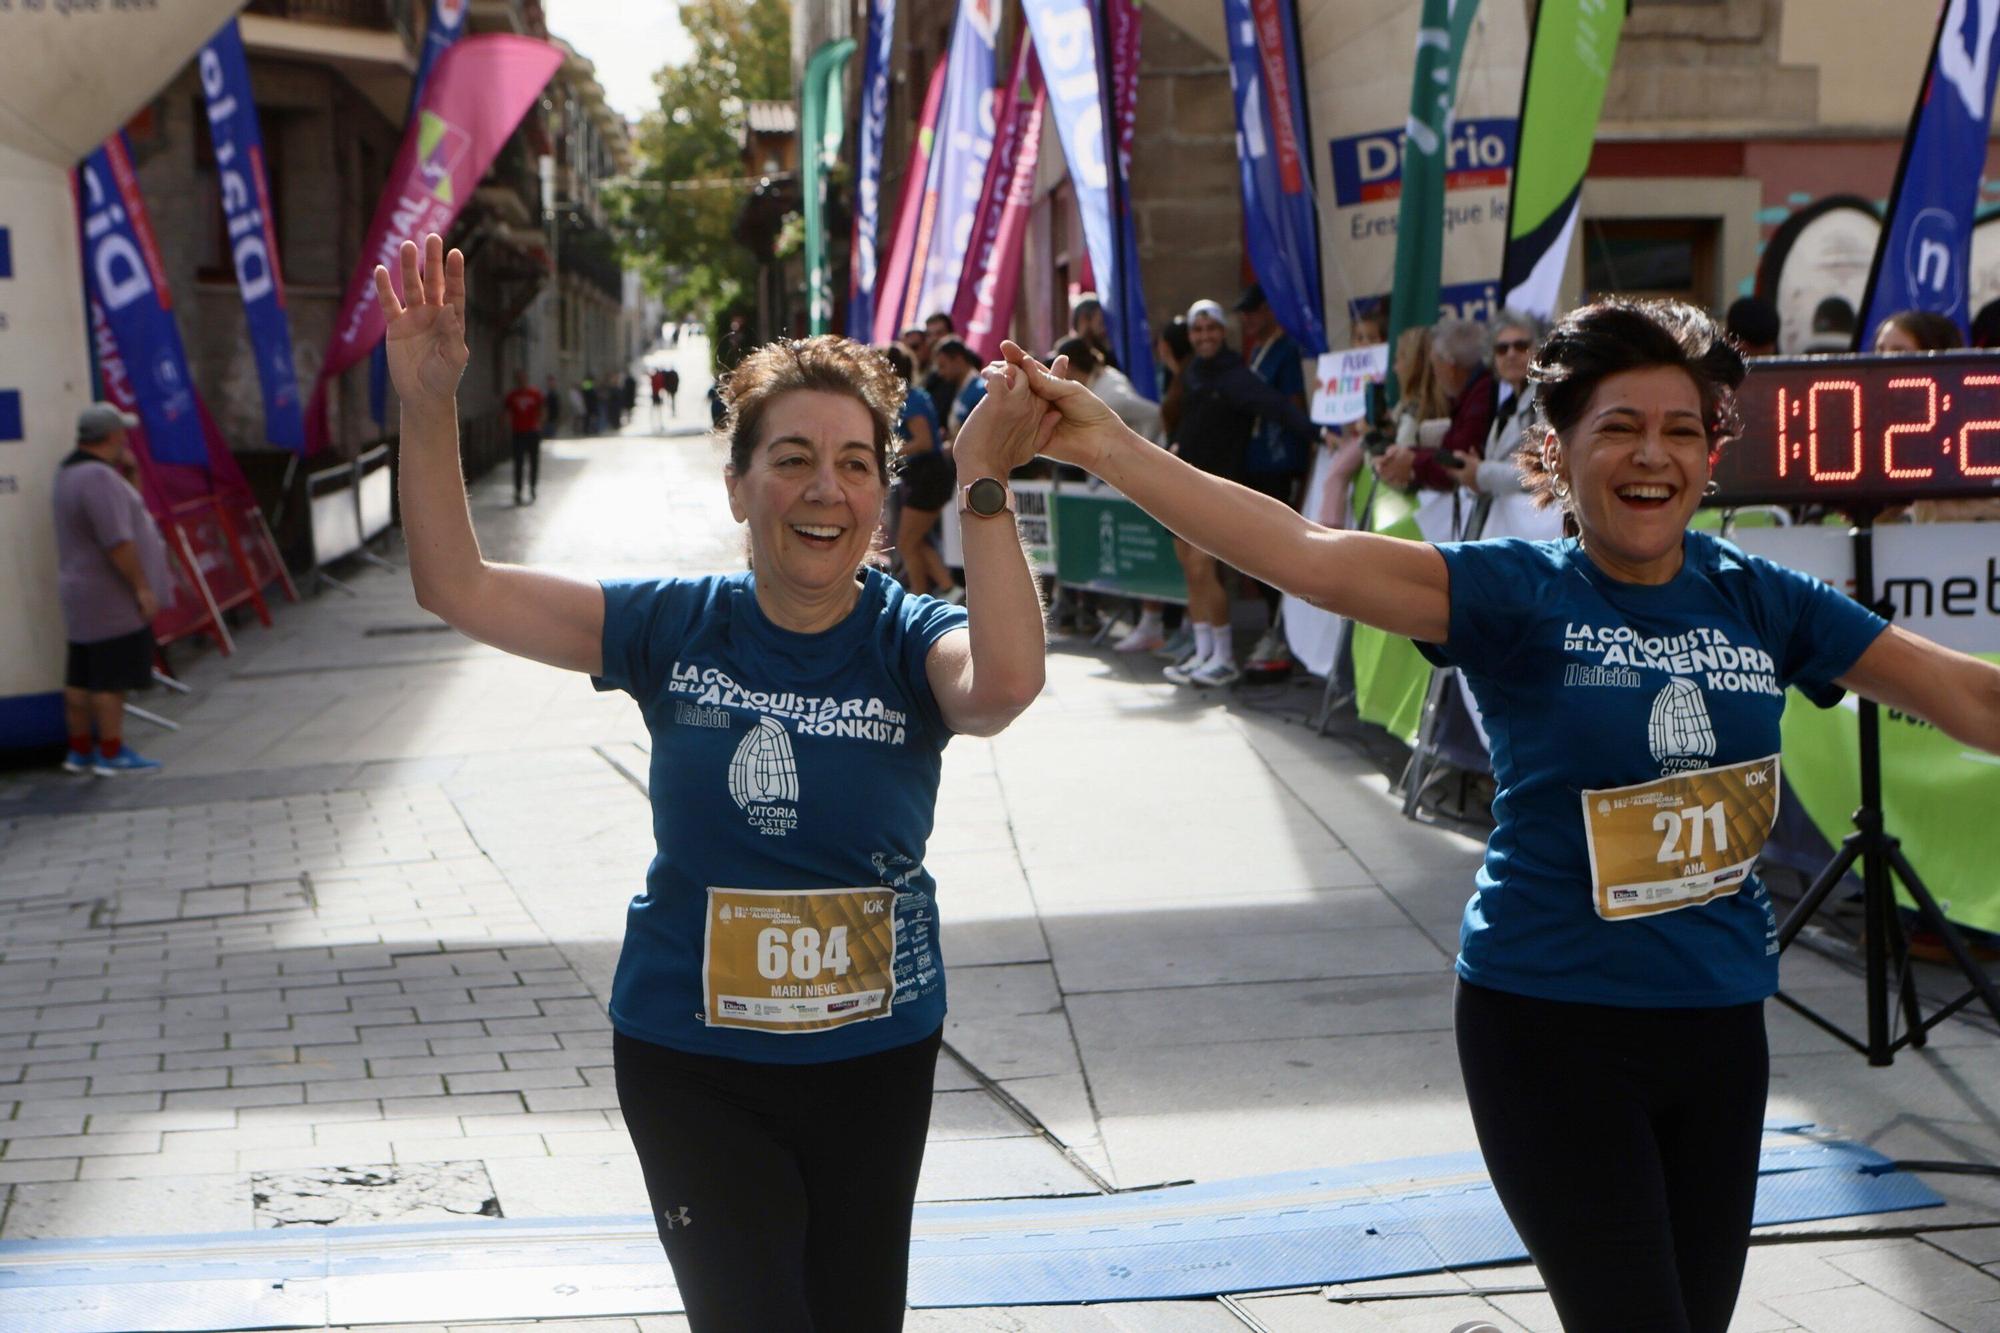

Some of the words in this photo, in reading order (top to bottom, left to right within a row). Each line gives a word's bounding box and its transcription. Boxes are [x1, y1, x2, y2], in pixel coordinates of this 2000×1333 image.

[1357, 126, 1506, 183] Dirio
[1565, 622, 1595, 641] LA
[1597, 626, 1731, 656] CONQUISTA
[1563, 640, 1584, 651] DE
[1586, 641, 1606, 652] LA
[1602, 644, 1776, 675] ALMENDRA
[671, 661, 700, 682] LA
[702, 668, 838, 712] CONQUISTA
[1579, 663, 1641, 688] Edición
[668, 680, 688, 692] DE
[688, 683, 706, 694] LA
[883, 708, 906, 725] REN
[797, 719, 906, 745] KONKISTA
[747, 805, 798, 819] VITORIA
[748, 816, 798, 829] GASTEIZ
[760, 827, 786, 836] 2025
[1652, 801, 1728, 863] 271
[1684, 861, 1707, 876] ANA
[863, 899, 885, 915] 10K
[757, 926, 851, 980] 684
[771, 984, 802, 998] MARI
[805, 983, 838, 997] NIEVE
